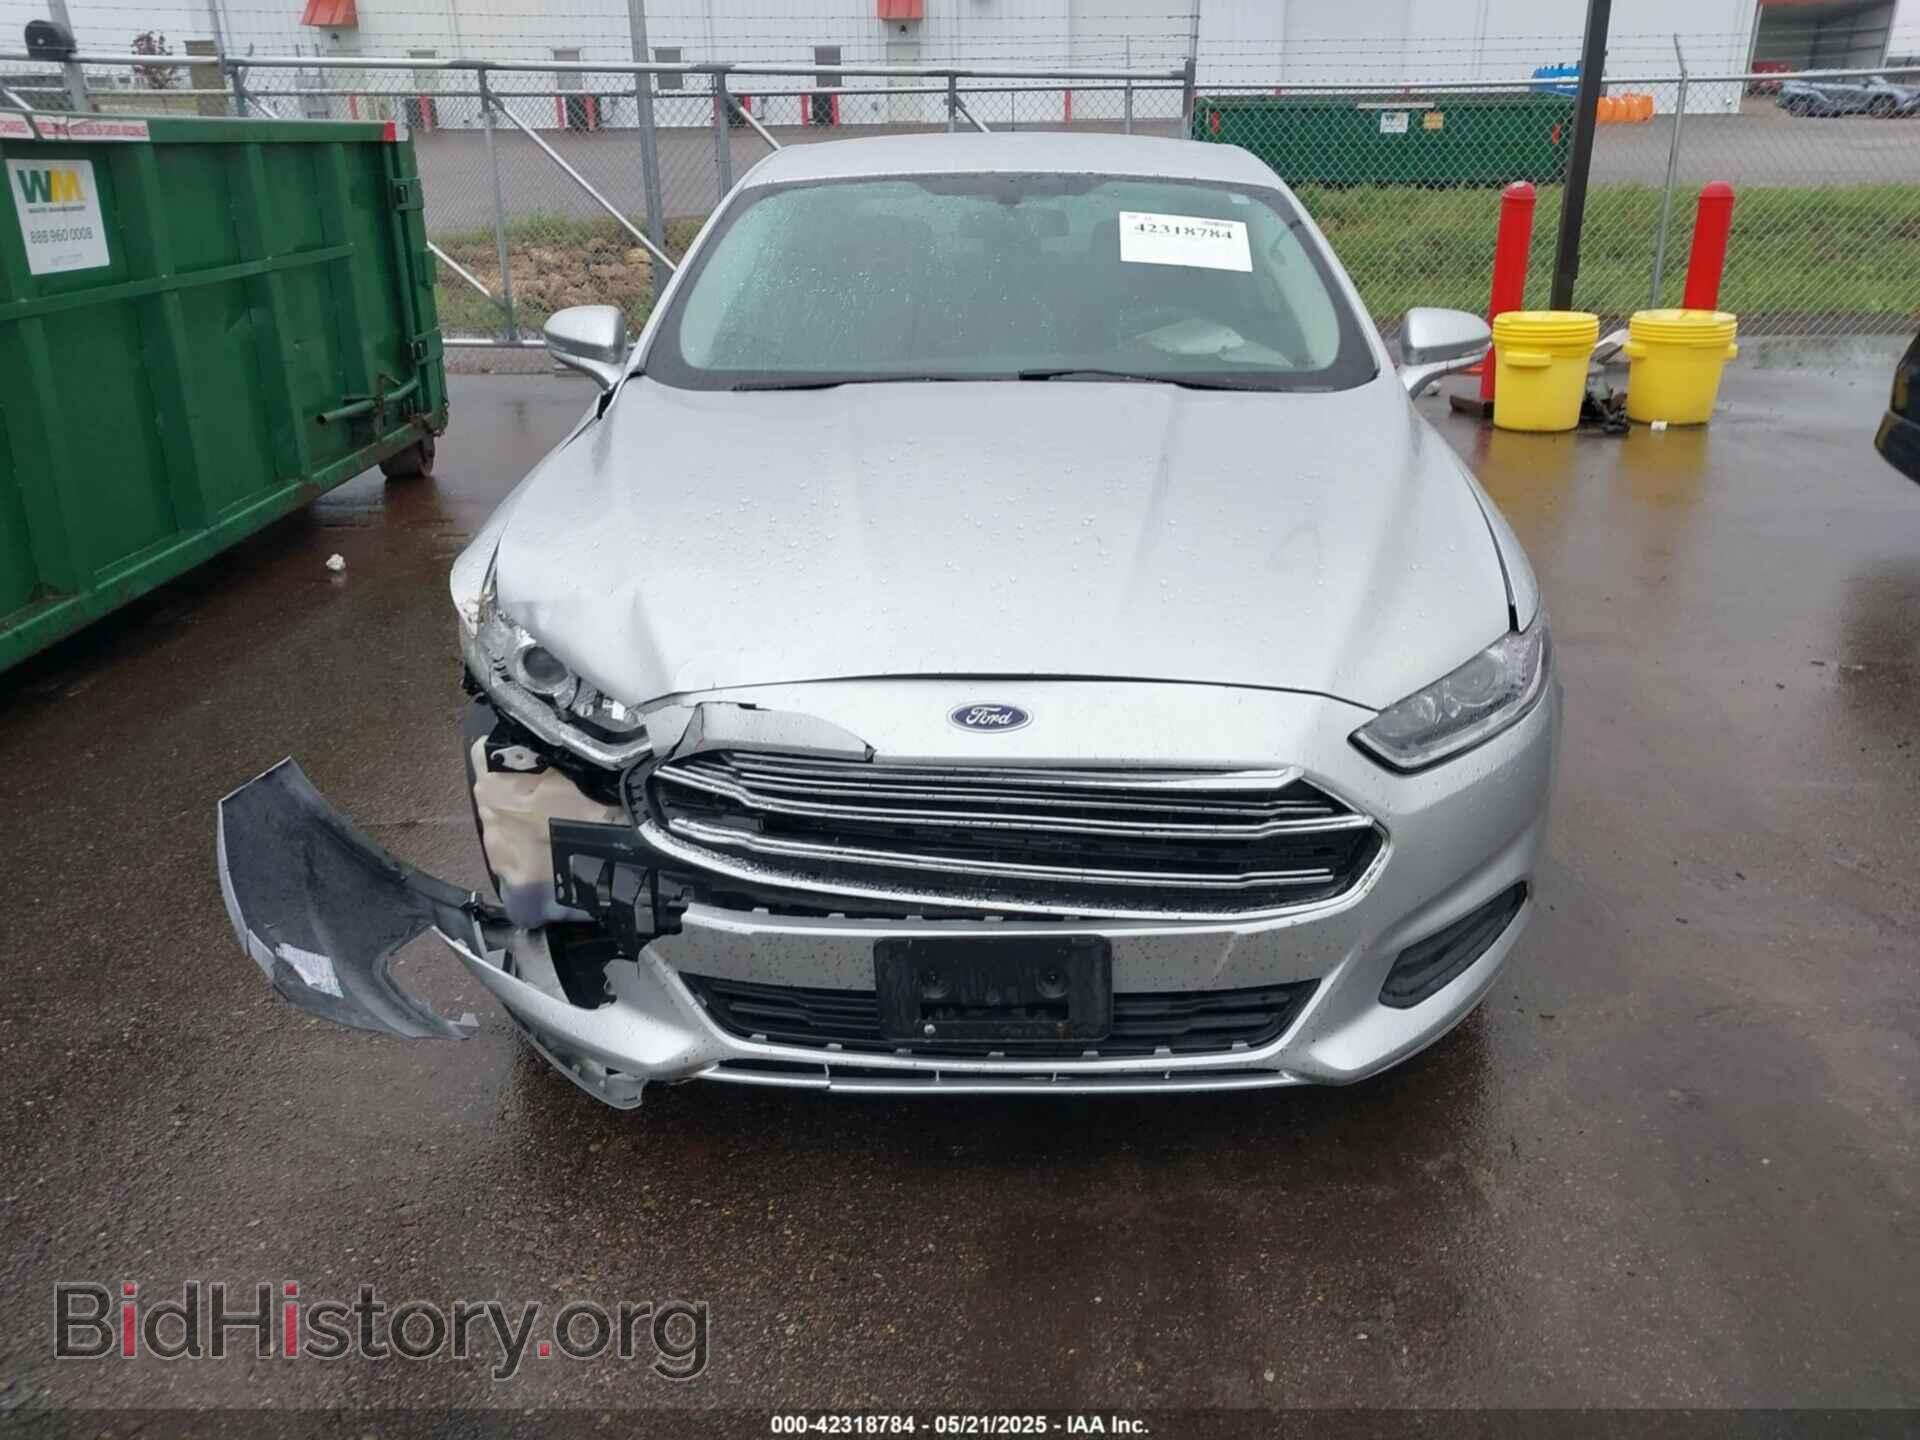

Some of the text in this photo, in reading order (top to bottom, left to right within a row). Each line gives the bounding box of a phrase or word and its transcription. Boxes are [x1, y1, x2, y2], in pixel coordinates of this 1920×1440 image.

[16, 169, 85, 203] WM
[49, 227, 69, 243] 960
[1134, 223, 1233, 240] 42318784
[966, 706, 1014, 725] Ford
